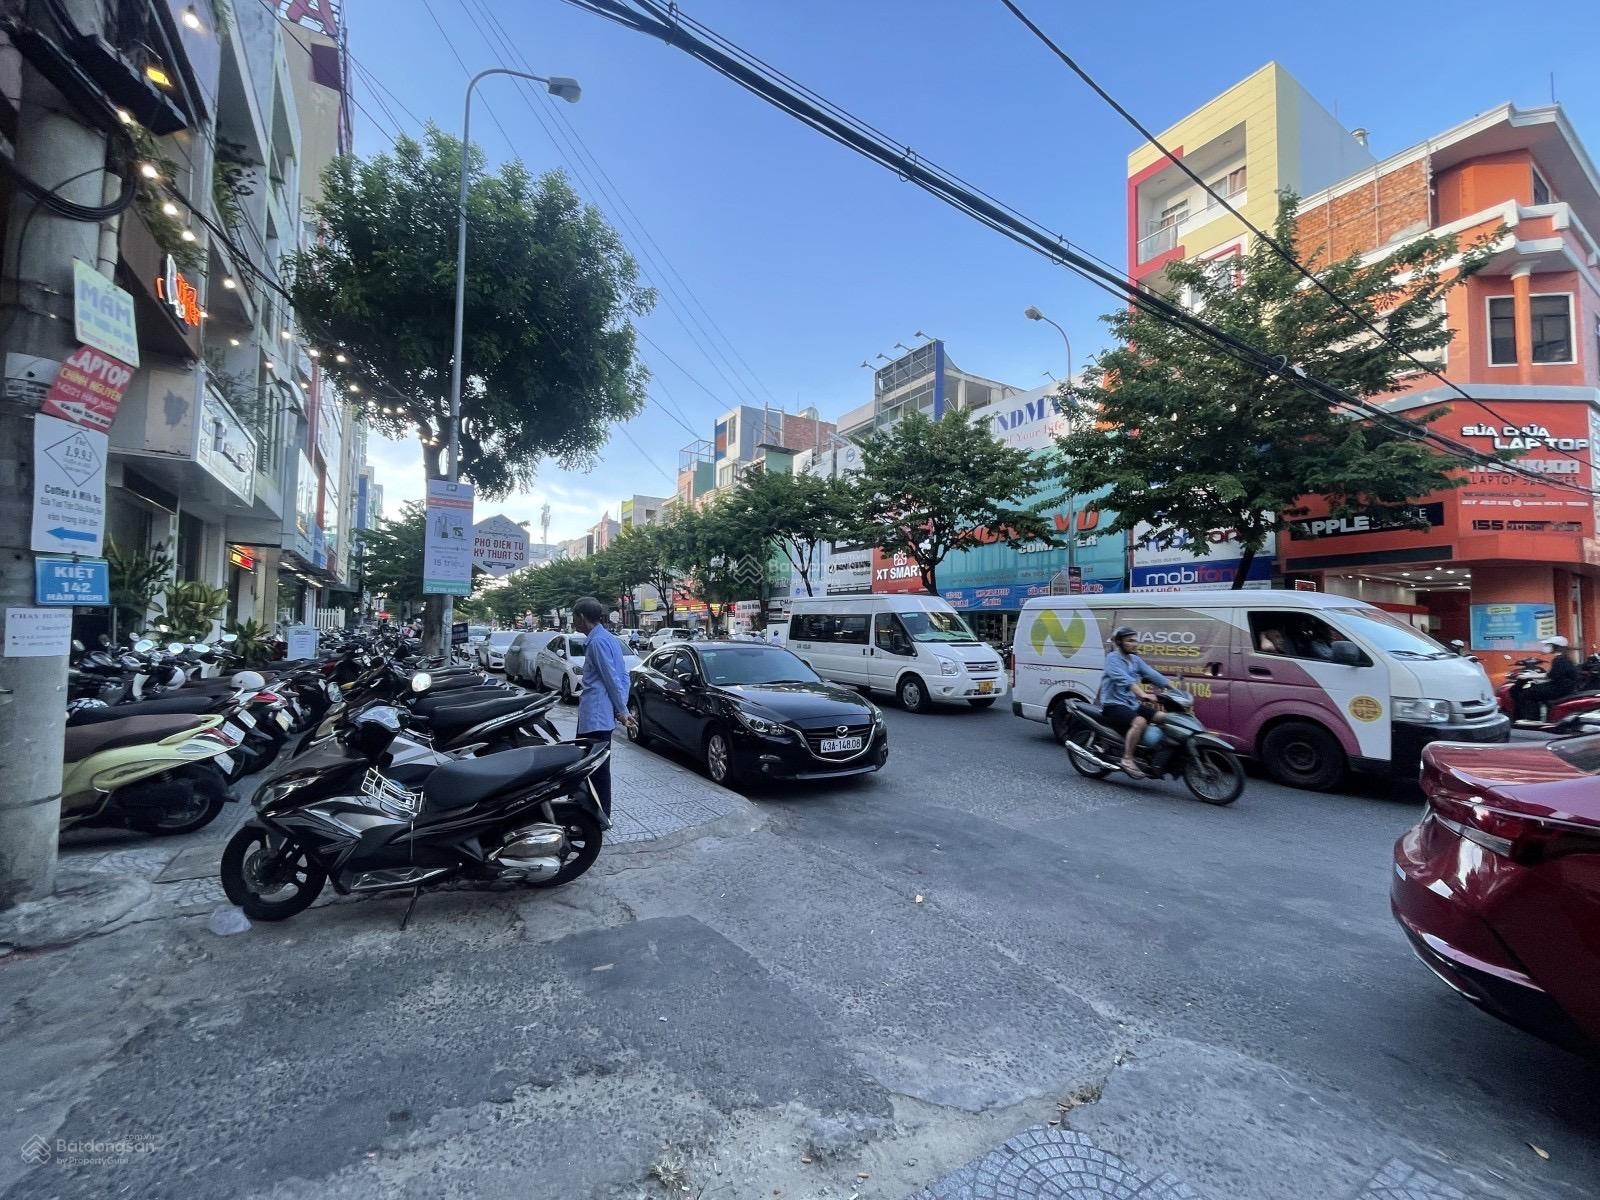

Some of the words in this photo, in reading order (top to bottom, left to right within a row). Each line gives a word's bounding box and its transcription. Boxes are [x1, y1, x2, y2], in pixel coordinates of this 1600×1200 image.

[66, 350, 131, 388] LAPTOP
[1494, 437, 1590, 450] LAPTOP
[877, 569, 889, 581] XT
[890, 565, 922, 579] SMART
[1146, 567, 1240, 586] mobifon
[61, 582, 92, 593] 142
